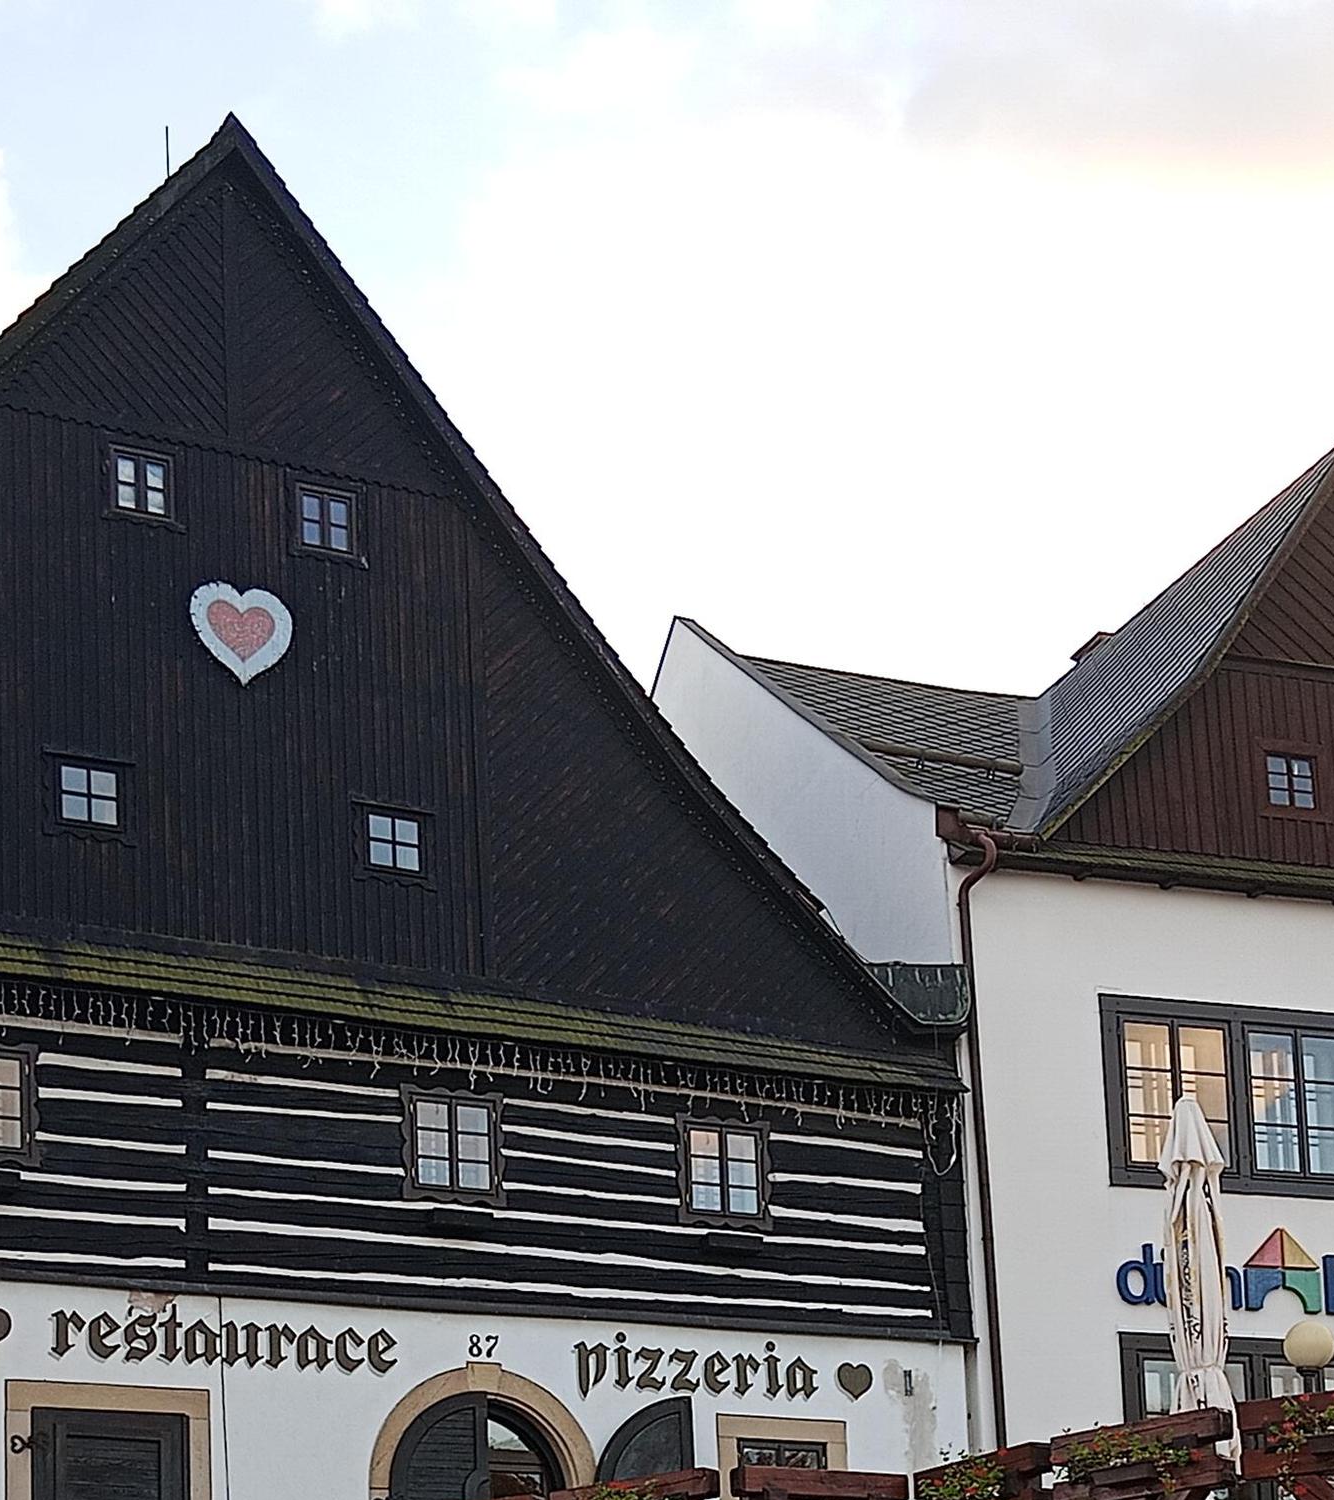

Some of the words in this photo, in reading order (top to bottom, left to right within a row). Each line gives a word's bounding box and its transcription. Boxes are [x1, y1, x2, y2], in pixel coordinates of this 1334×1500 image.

[49, 1303, 399, 1374] restaurace
[468, 1333, 500, 1359] 87
[572, 1331, 819, 1400] pizzeria
